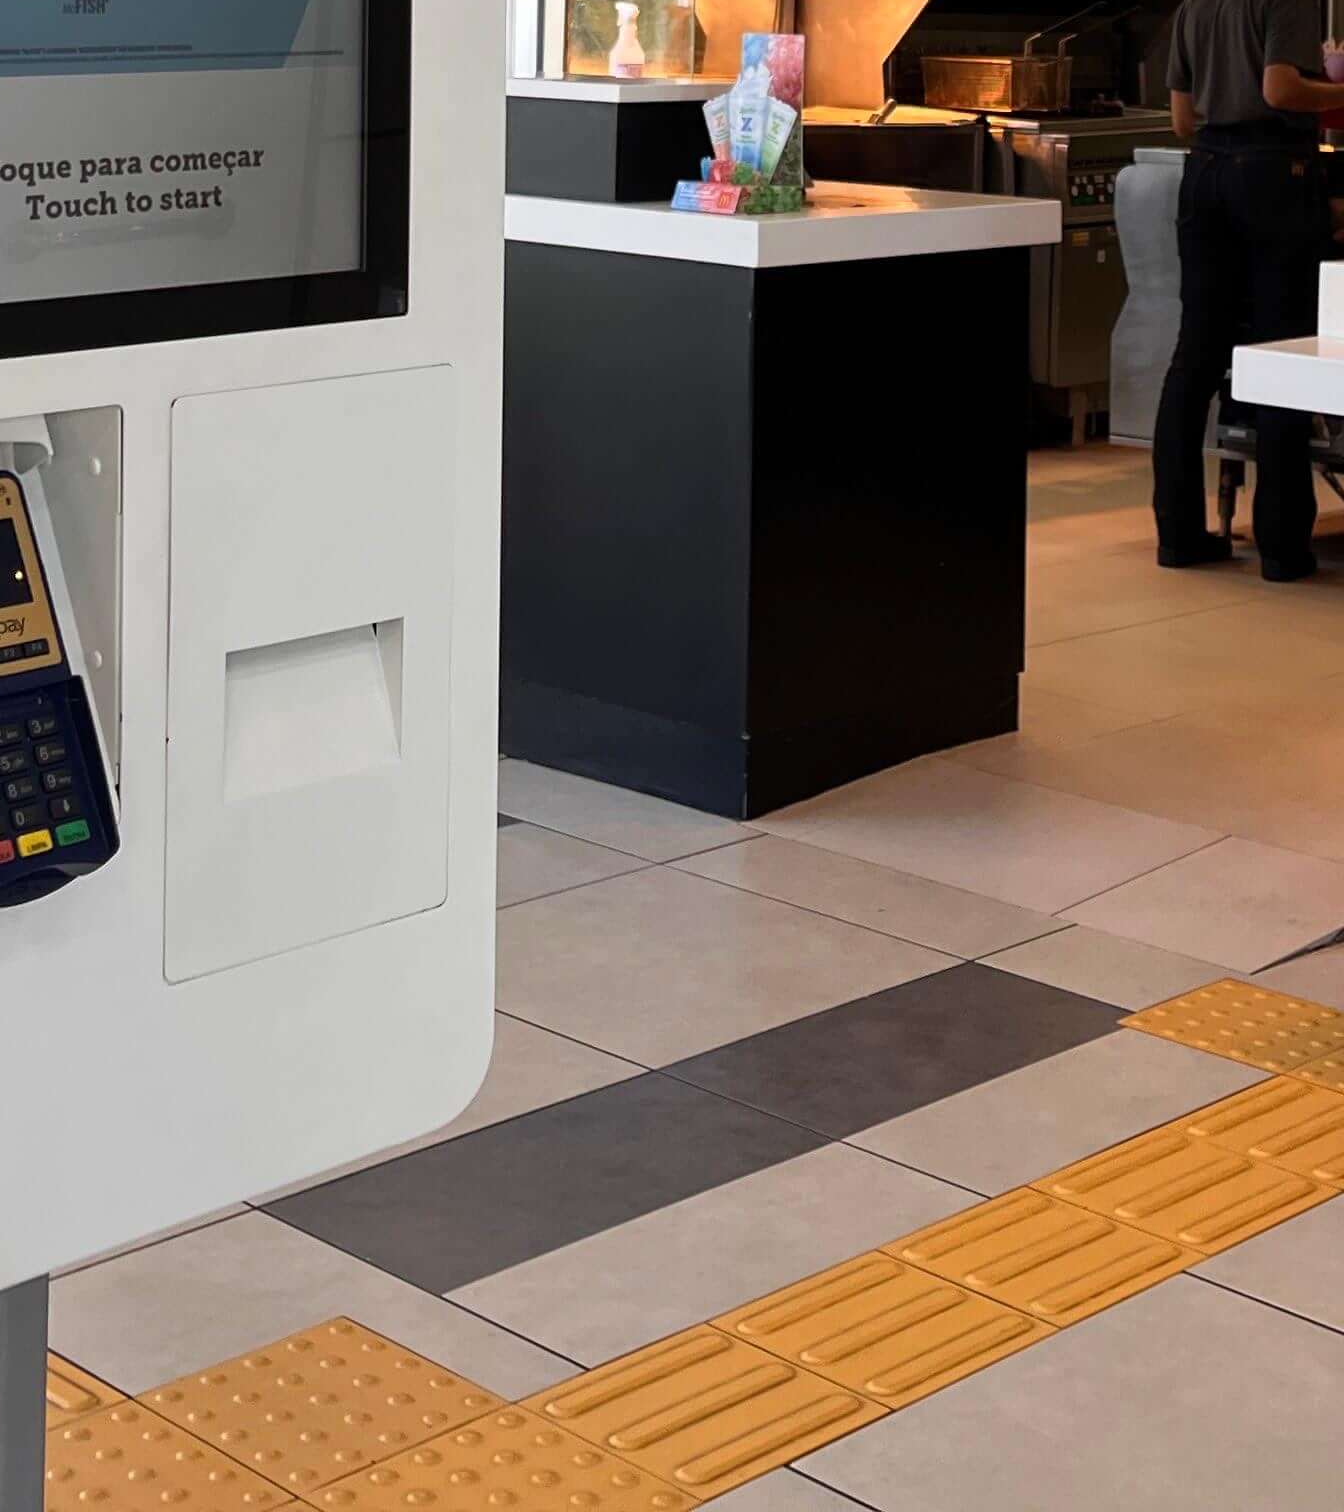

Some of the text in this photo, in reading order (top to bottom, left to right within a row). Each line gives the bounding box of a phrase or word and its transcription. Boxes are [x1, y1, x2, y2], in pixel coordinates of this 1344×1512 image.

[79, 154, 143, 184] para
[150, 145, 265, 180] começar
[25, 184, 223, 222] Touch to start
